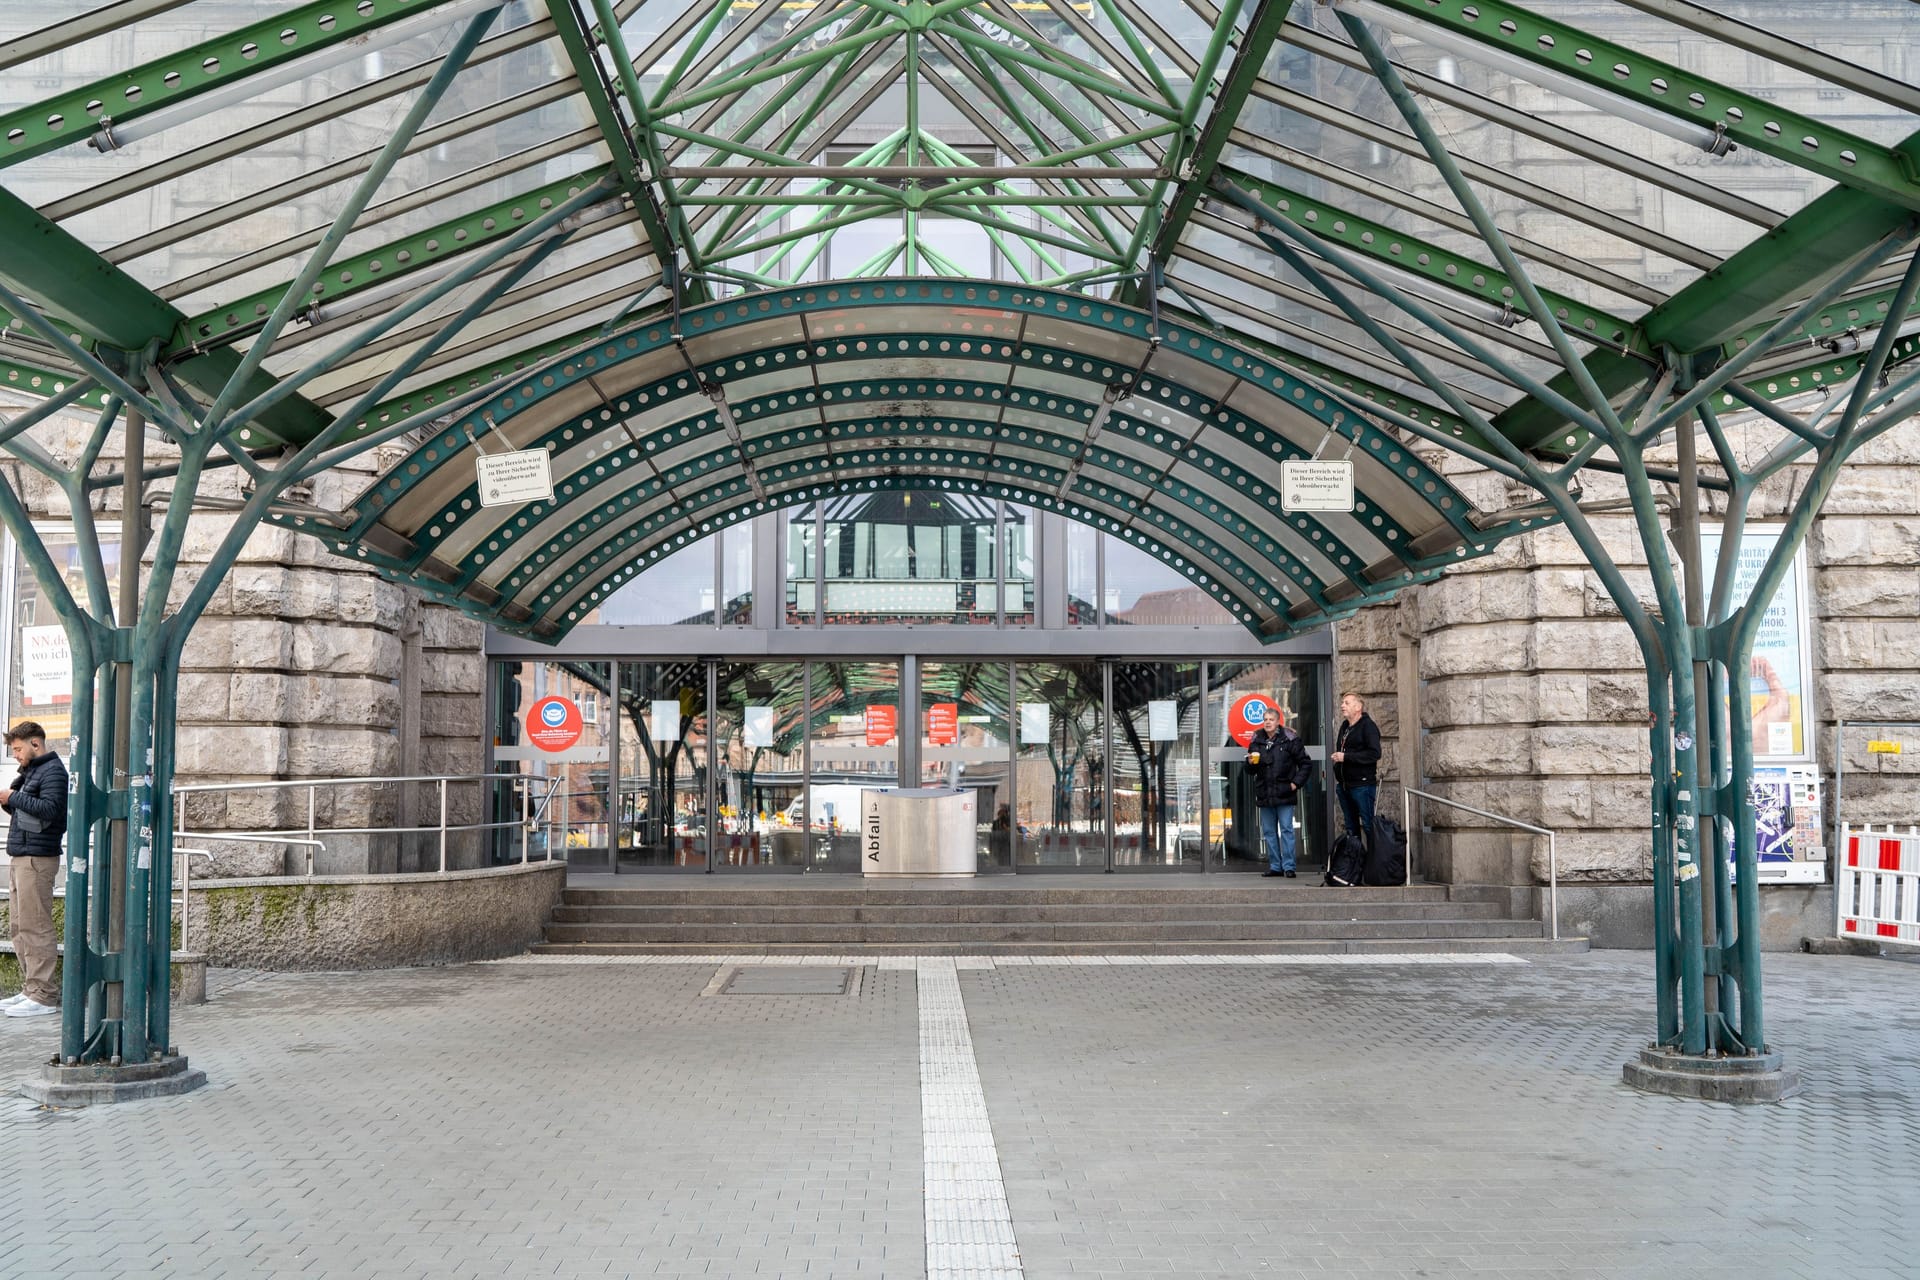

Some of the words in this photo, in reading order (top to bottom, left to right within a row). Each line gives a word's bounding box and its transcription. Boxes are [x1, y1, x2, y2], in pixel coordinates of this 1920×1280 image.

[505, 458, 527, 466] Bereich
[511, 464, 540, 472] Sicherheit
[31, 651, 48, 660] wo
[50, 647, 68, 660] ich
[868, 815, 880, 862] Abfall
